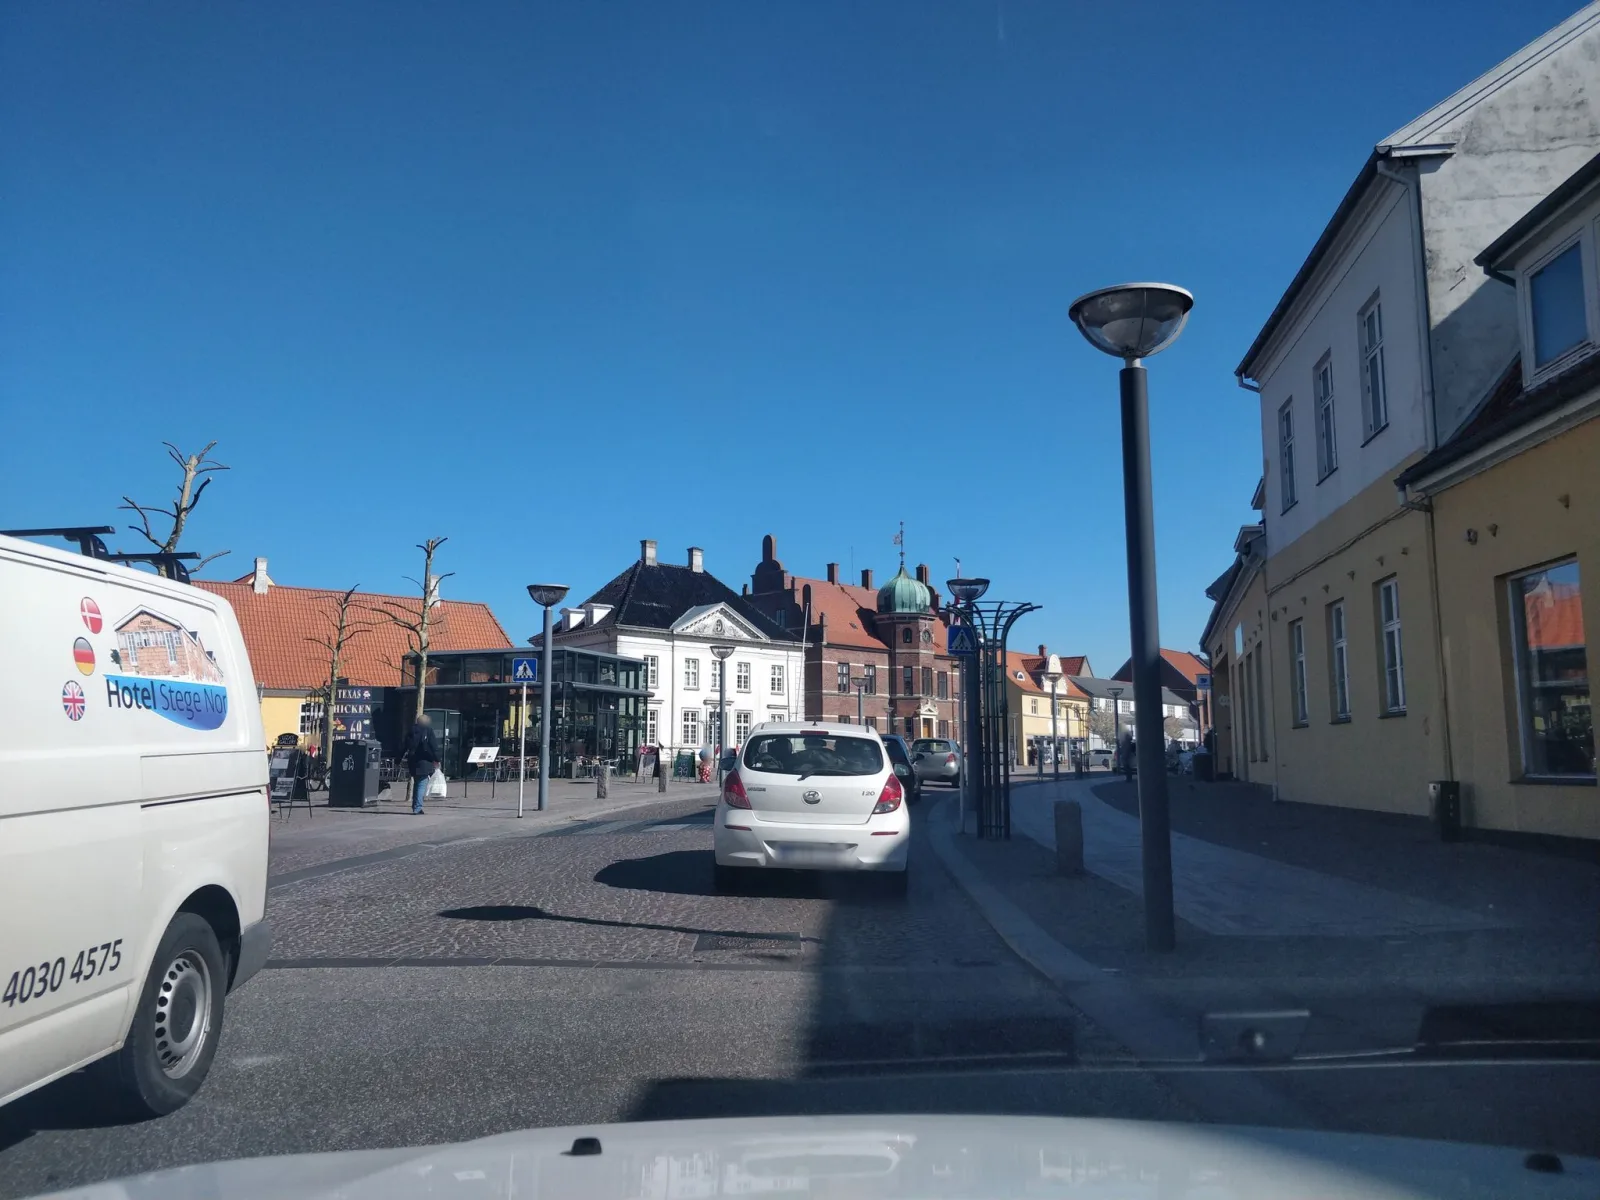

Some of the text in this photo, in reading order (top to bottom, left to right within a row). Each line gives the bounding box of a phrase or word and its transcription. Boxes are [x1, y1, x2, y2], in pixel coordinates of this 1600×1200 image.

[106, 679, 157, 709] Hotel
[160, 684, 202, 720] Stege
[337, 689, 361, 699] TEXAS
[333, 704, 371, 714] HICKEN
[2, 938, 123, 1008] 4030 4575
